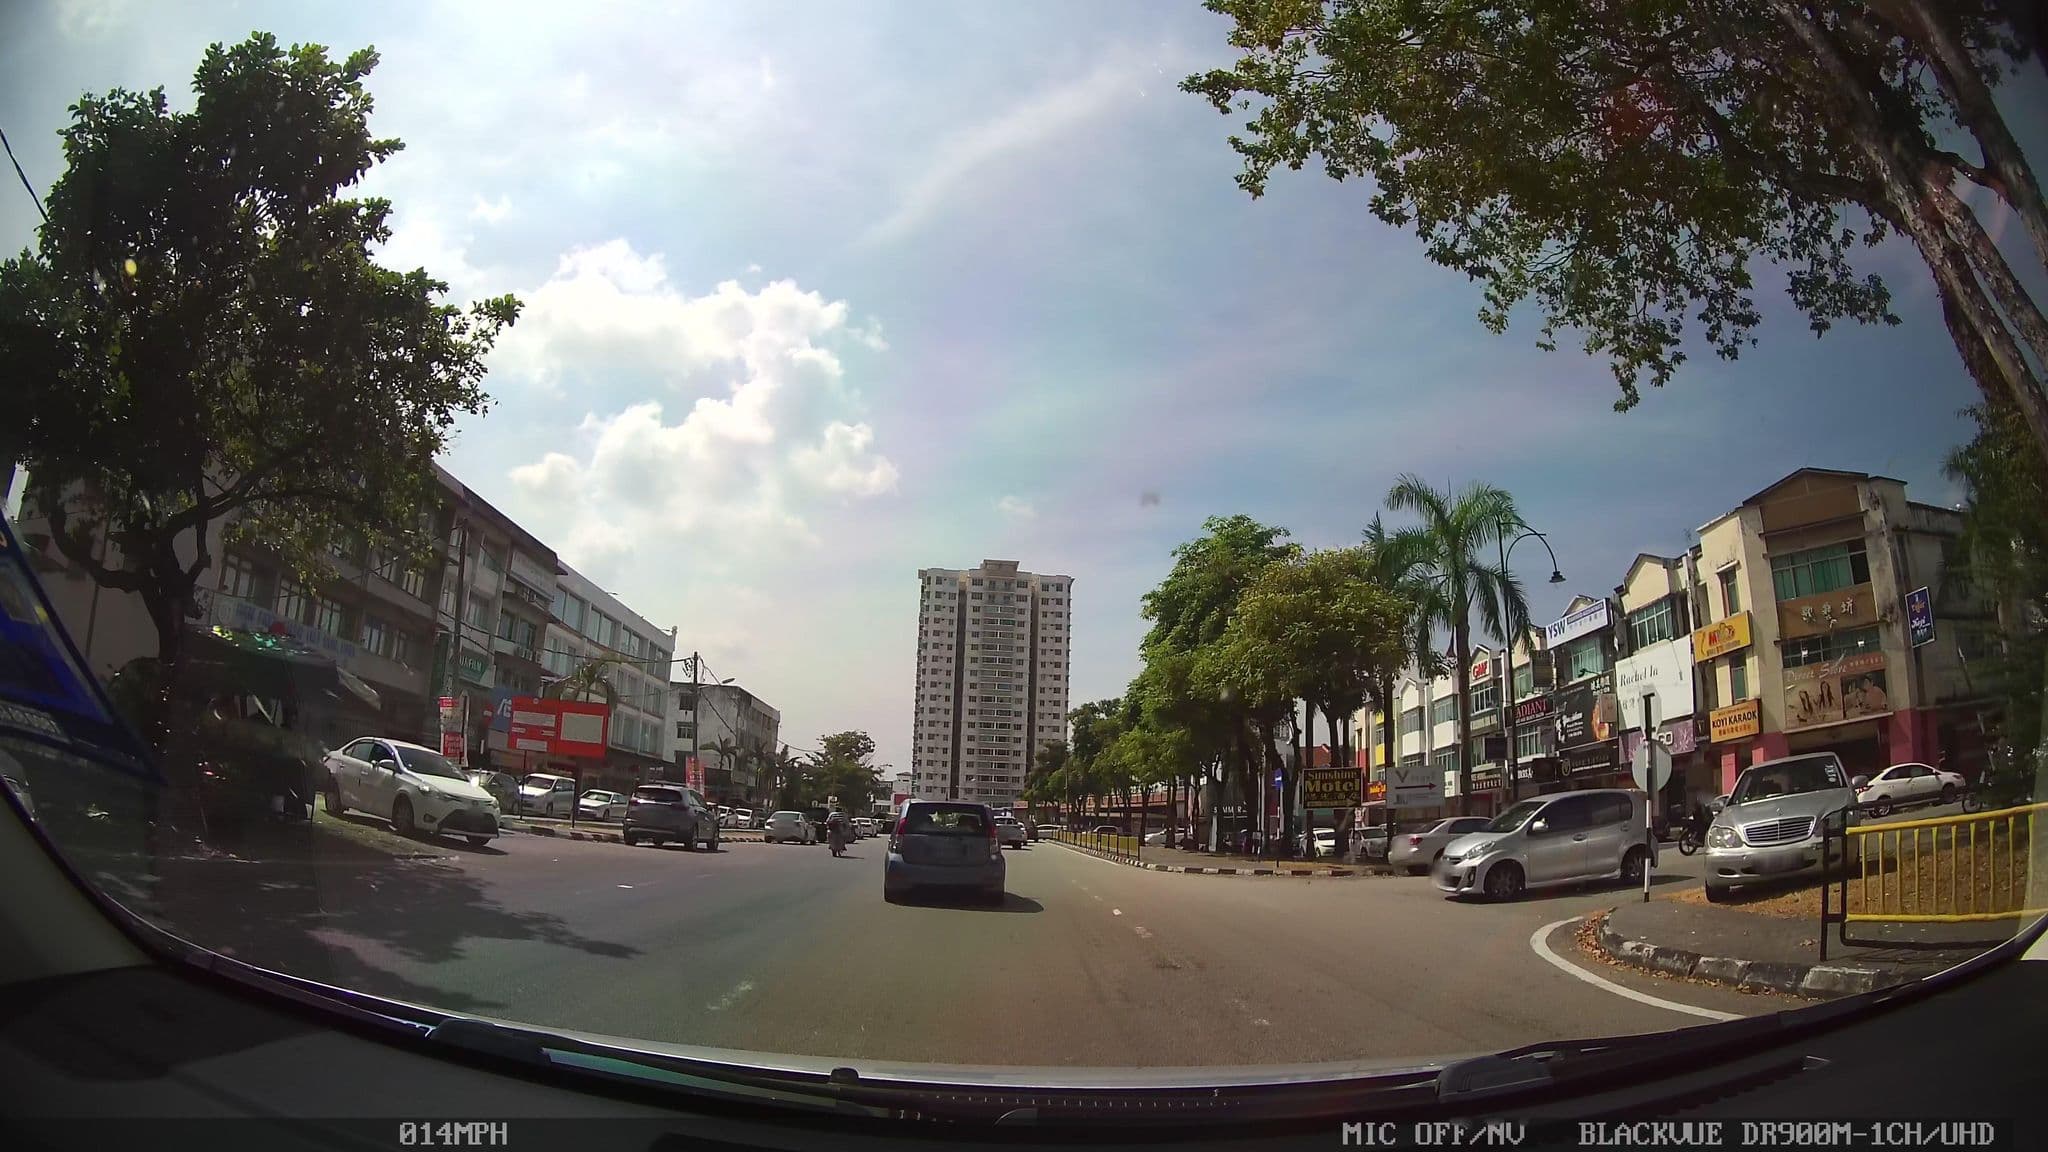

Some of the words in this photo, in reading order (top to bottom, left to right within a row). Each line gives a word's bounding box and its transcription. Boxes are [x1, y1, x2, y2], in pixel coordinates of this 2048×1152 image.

[1548, 619, 1566, 639] YSW
[1515, 699, 1546, 718] ADIANT
[1712, 717, 1728, 728] KOYI
[1308, 770, 1358, 780] Sunshine
[1305, 779, 1360, 792] Motel
